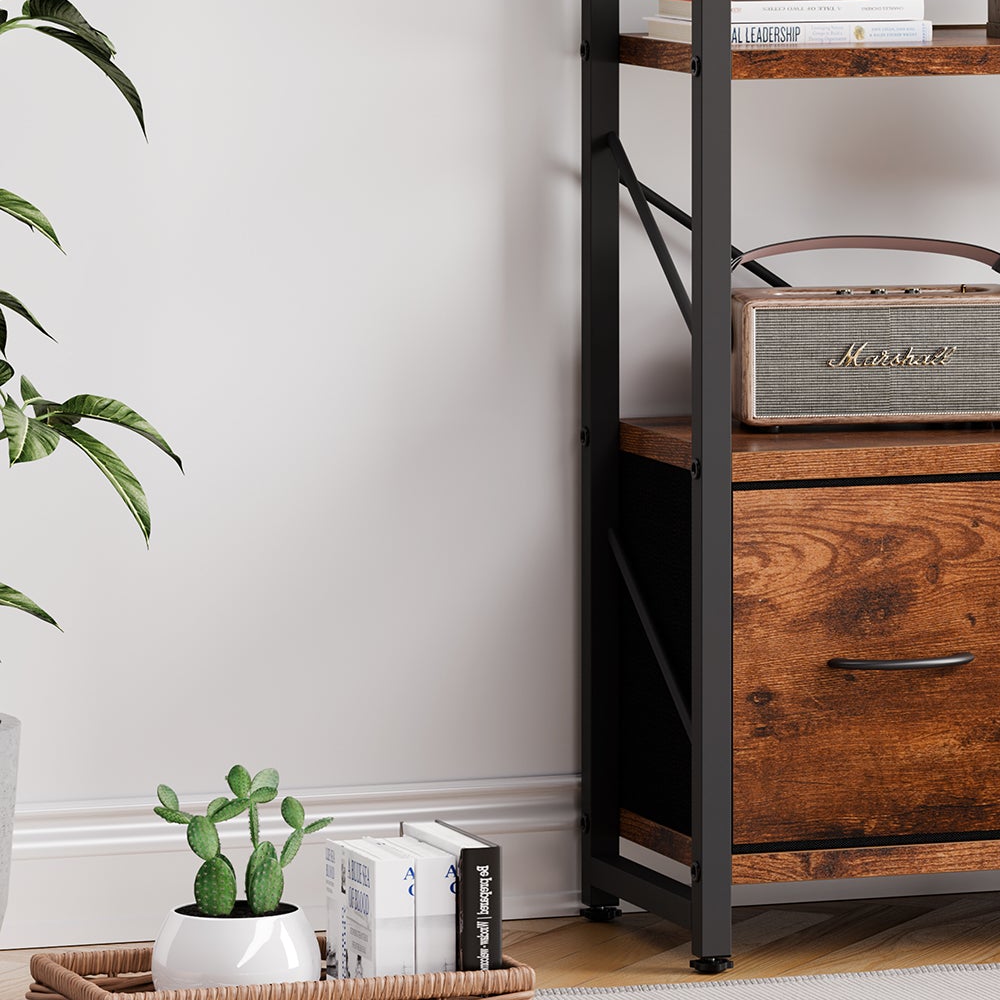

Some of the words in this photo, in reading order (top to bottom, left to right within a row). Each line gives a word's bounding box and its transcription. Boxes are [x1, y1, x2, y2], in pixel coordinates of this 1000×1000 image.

[731, 26, 743, 44] AL
[745, 26, 801, 44] LEADERSHIP
[826, 341, 958, 368] Marshall
